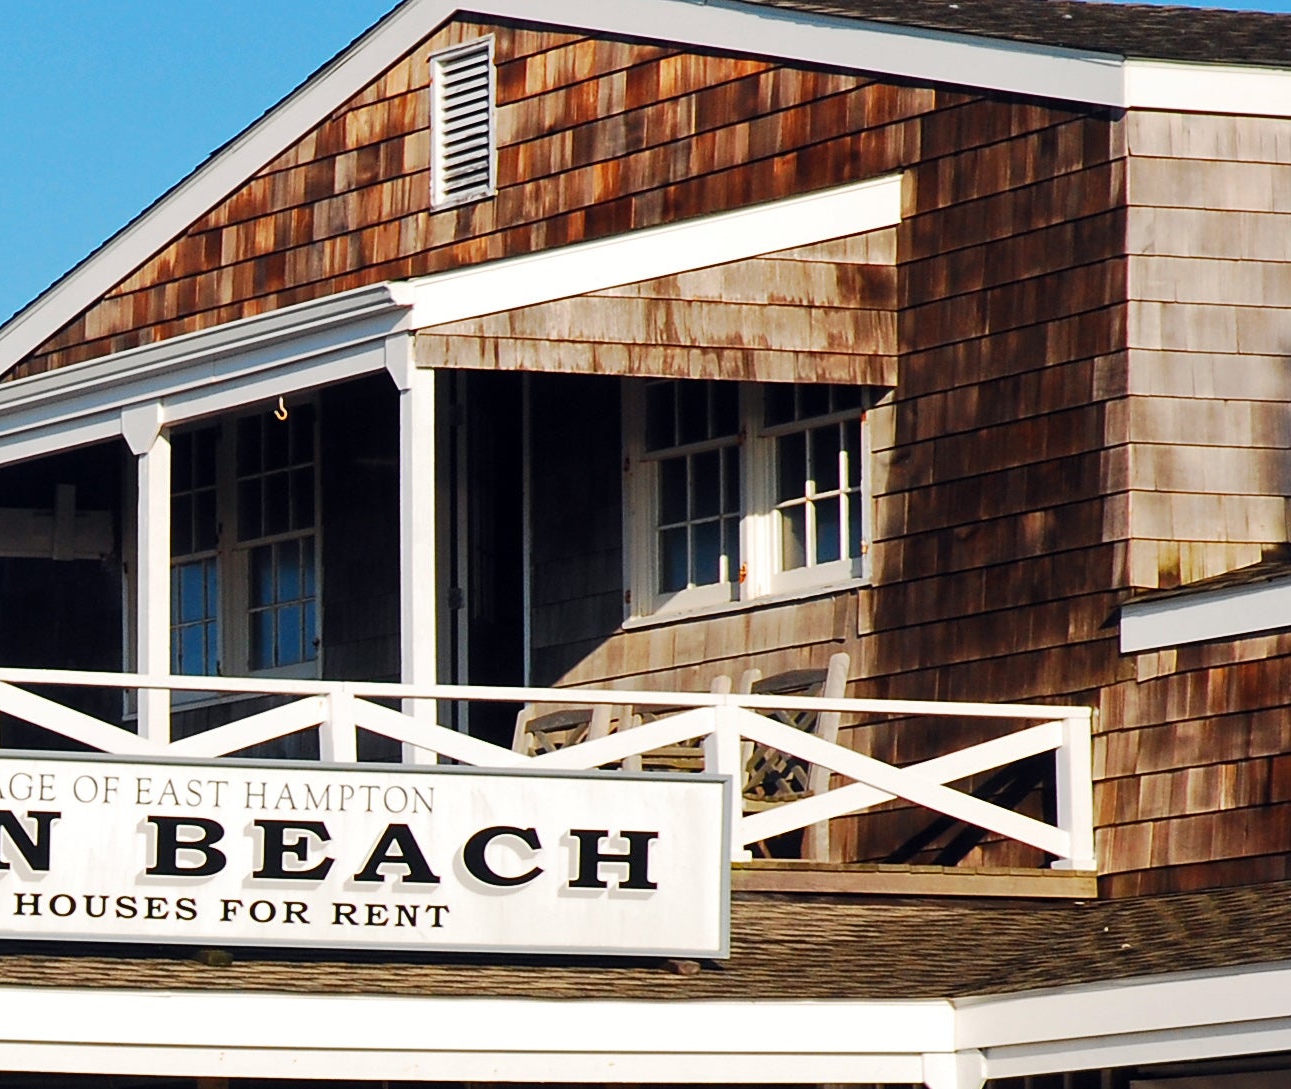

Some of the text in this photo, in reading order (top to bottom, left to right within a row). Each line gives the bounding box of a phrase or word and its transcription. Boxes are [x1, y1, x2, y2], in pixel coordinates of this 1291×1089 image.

[73, 775, 119, 803] OF
[135, 777, 229, 808] EAST
[245, 781, 435, 813] HAMPTON
[145, 815, 659, 890] BEACH
[13, 893, 198, 921] HOUSES
[220, 899, 310, 924] FOR
[332, 902, 450, 928] RENT
